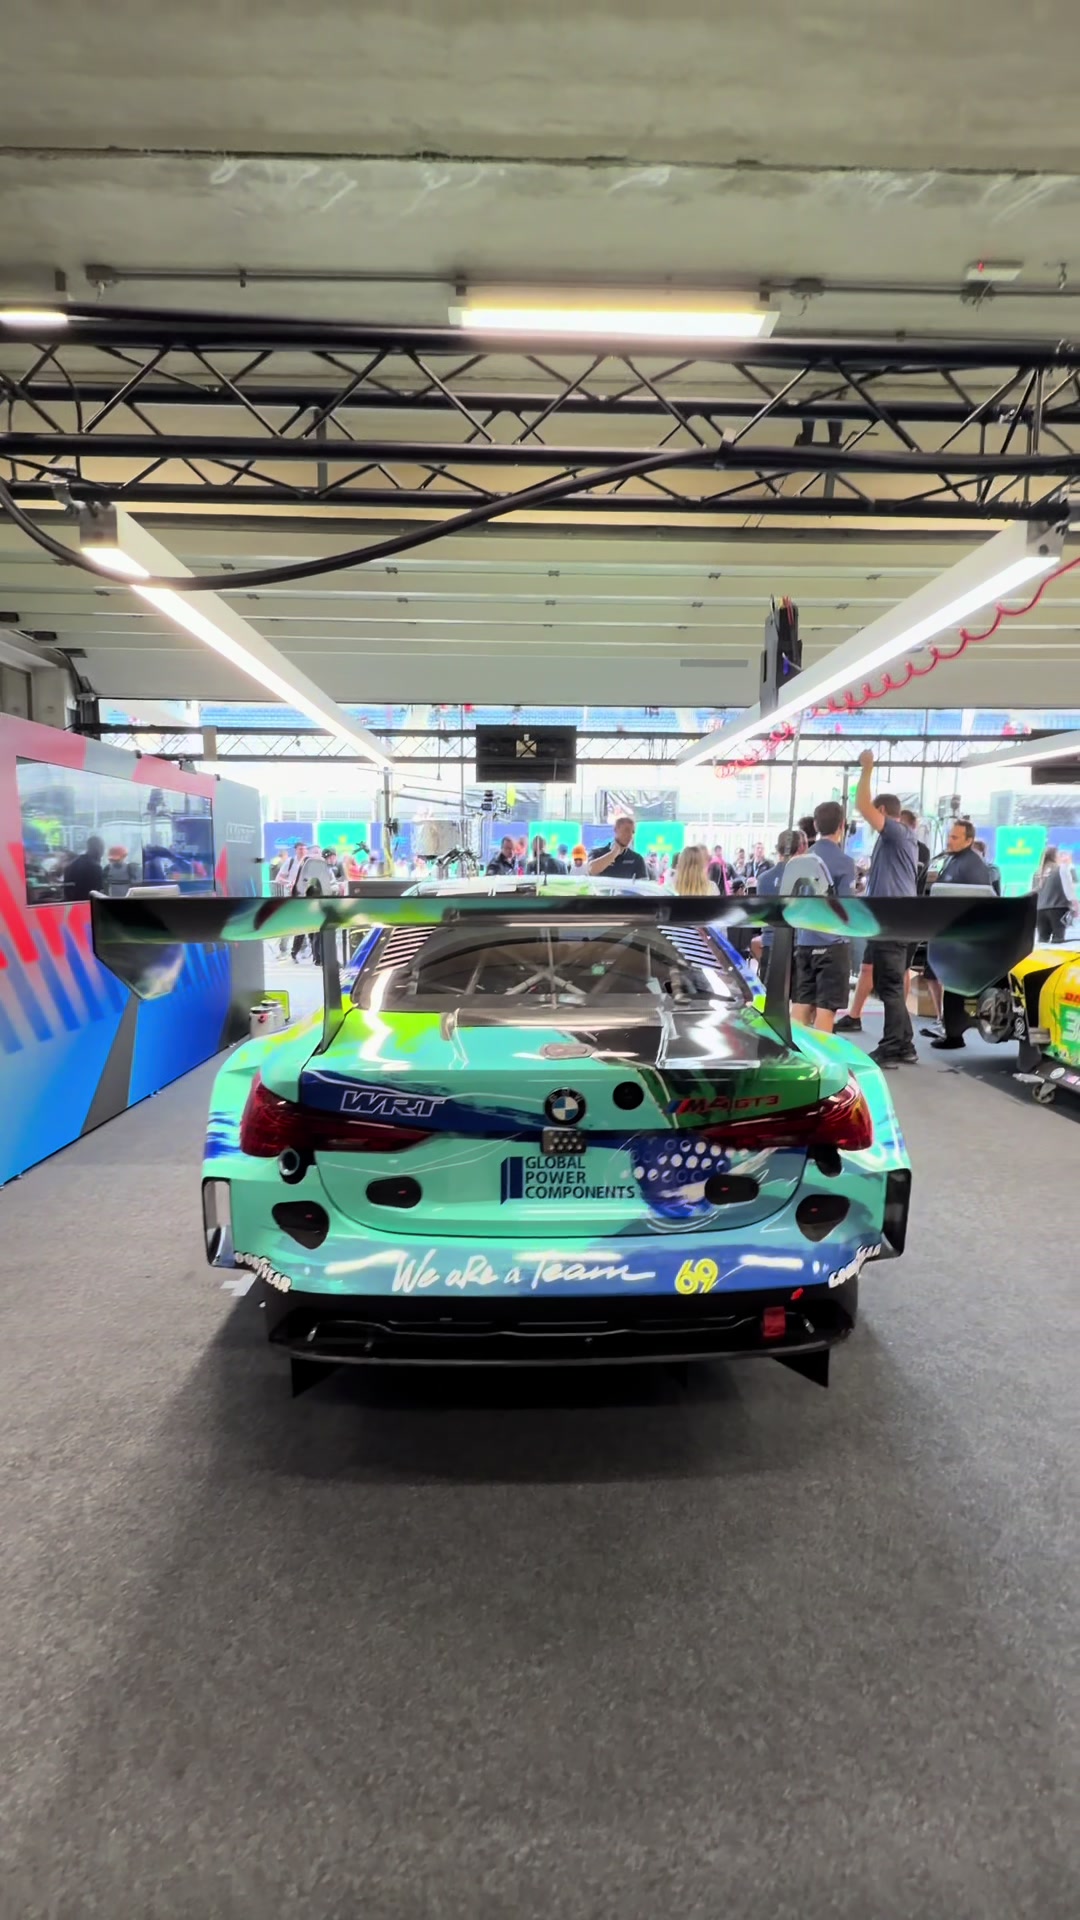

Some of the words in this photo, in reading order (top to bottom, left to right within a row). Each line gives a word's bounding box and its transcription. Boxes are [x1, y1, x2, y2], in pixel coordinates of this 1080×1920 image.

[340, 1090, 446, 1117] WRT
[734, 1095, 779, 1109] GT3
[525, 1156, 586, 1169] GLOBAL
[525, 1171, 586, 1184] POWER
[525, 1186, 636, 1199] COMPONENTS
[391, 1248, 440, 1293] We
[503, 1266, 522, 1284] a
[531, 1253, 656, 1289] Team
[674, 1258, 719, 1295] 69
